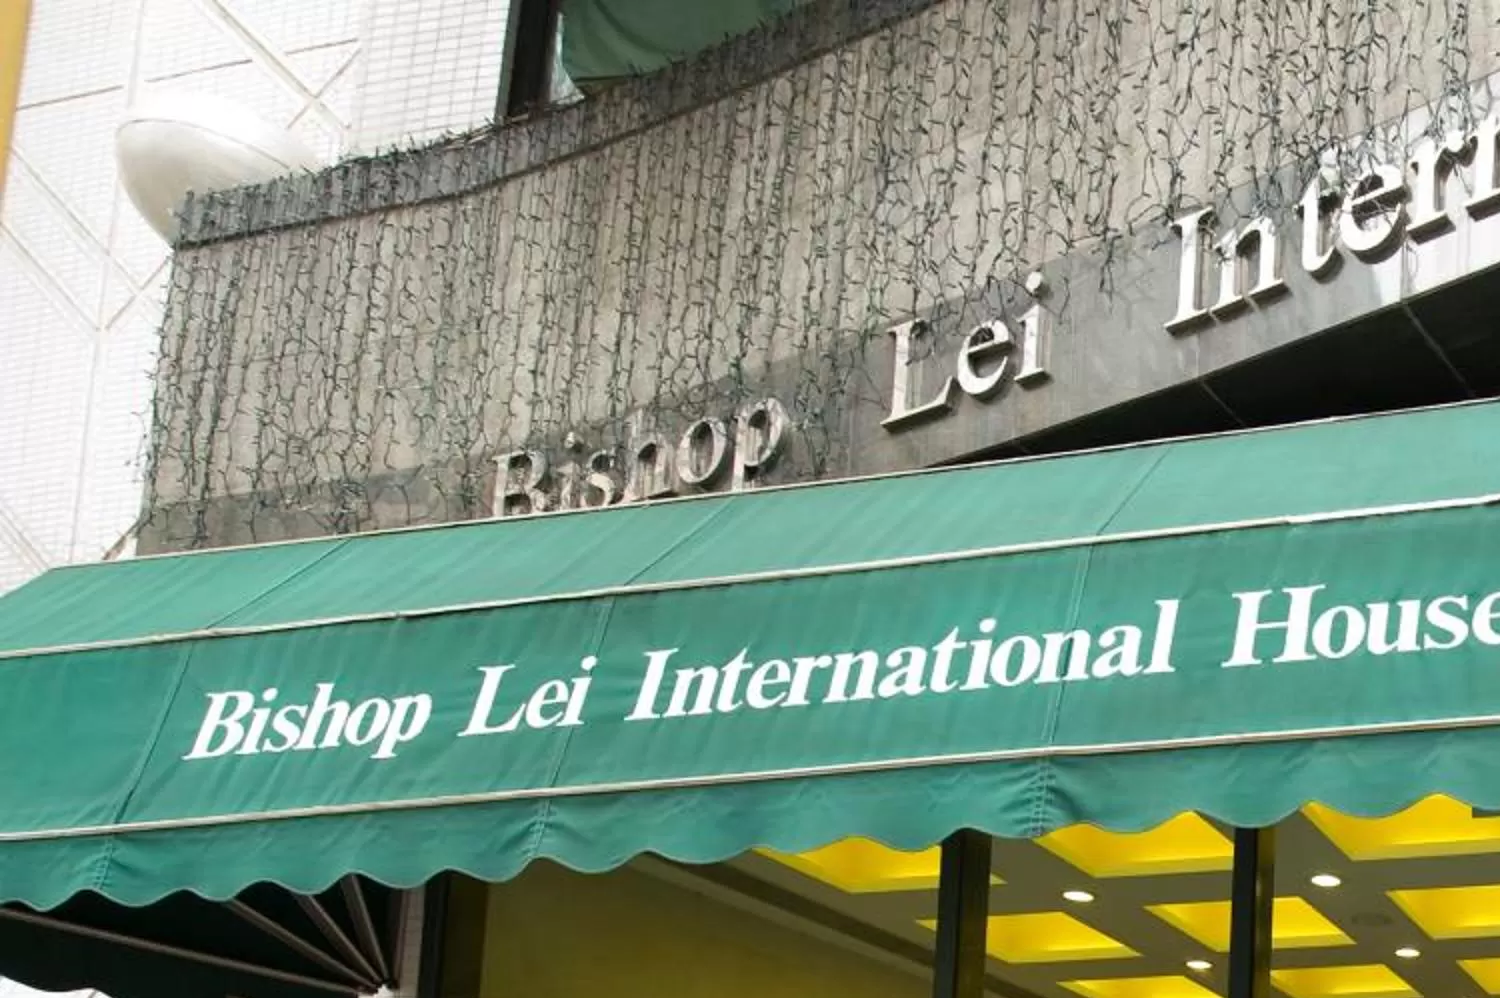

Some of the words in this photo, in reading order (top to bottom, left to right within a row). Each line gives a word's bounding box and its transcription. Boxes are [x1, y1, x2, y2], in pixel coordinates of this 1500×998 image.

[491, 397, 788, 517] Bishop
[879, 270, 1050, 432] Lei
[182, 683, 433, 761] Bishop
[456, 656, 599, 738] Lei
[623, 599, 1180, 723] International
